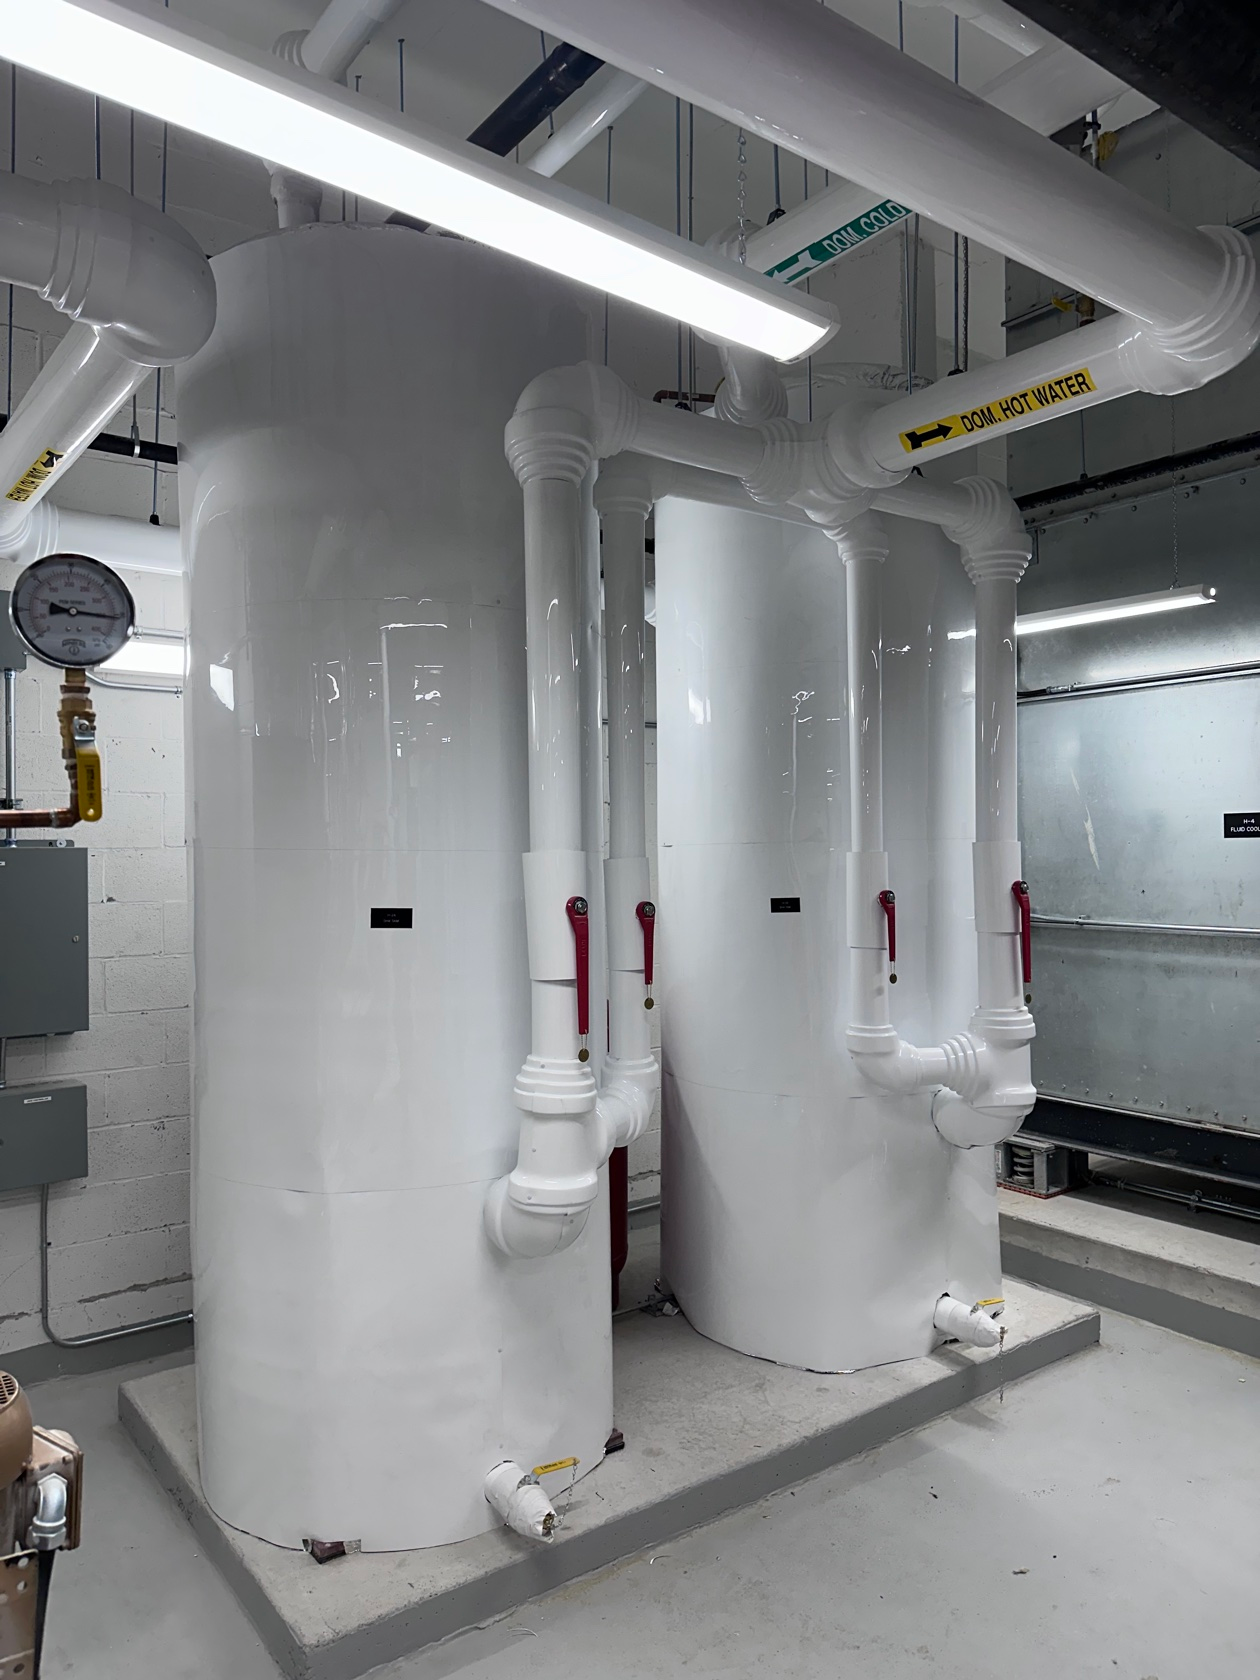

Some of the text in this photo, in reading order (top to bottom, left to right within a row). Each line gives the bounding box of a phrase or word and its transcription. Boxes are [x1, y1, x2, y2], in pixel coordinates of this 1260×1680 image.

[822, 201, 907, 254] DOM. COLD
[960, 372, 1092, 432] DOM. HOT WATER
